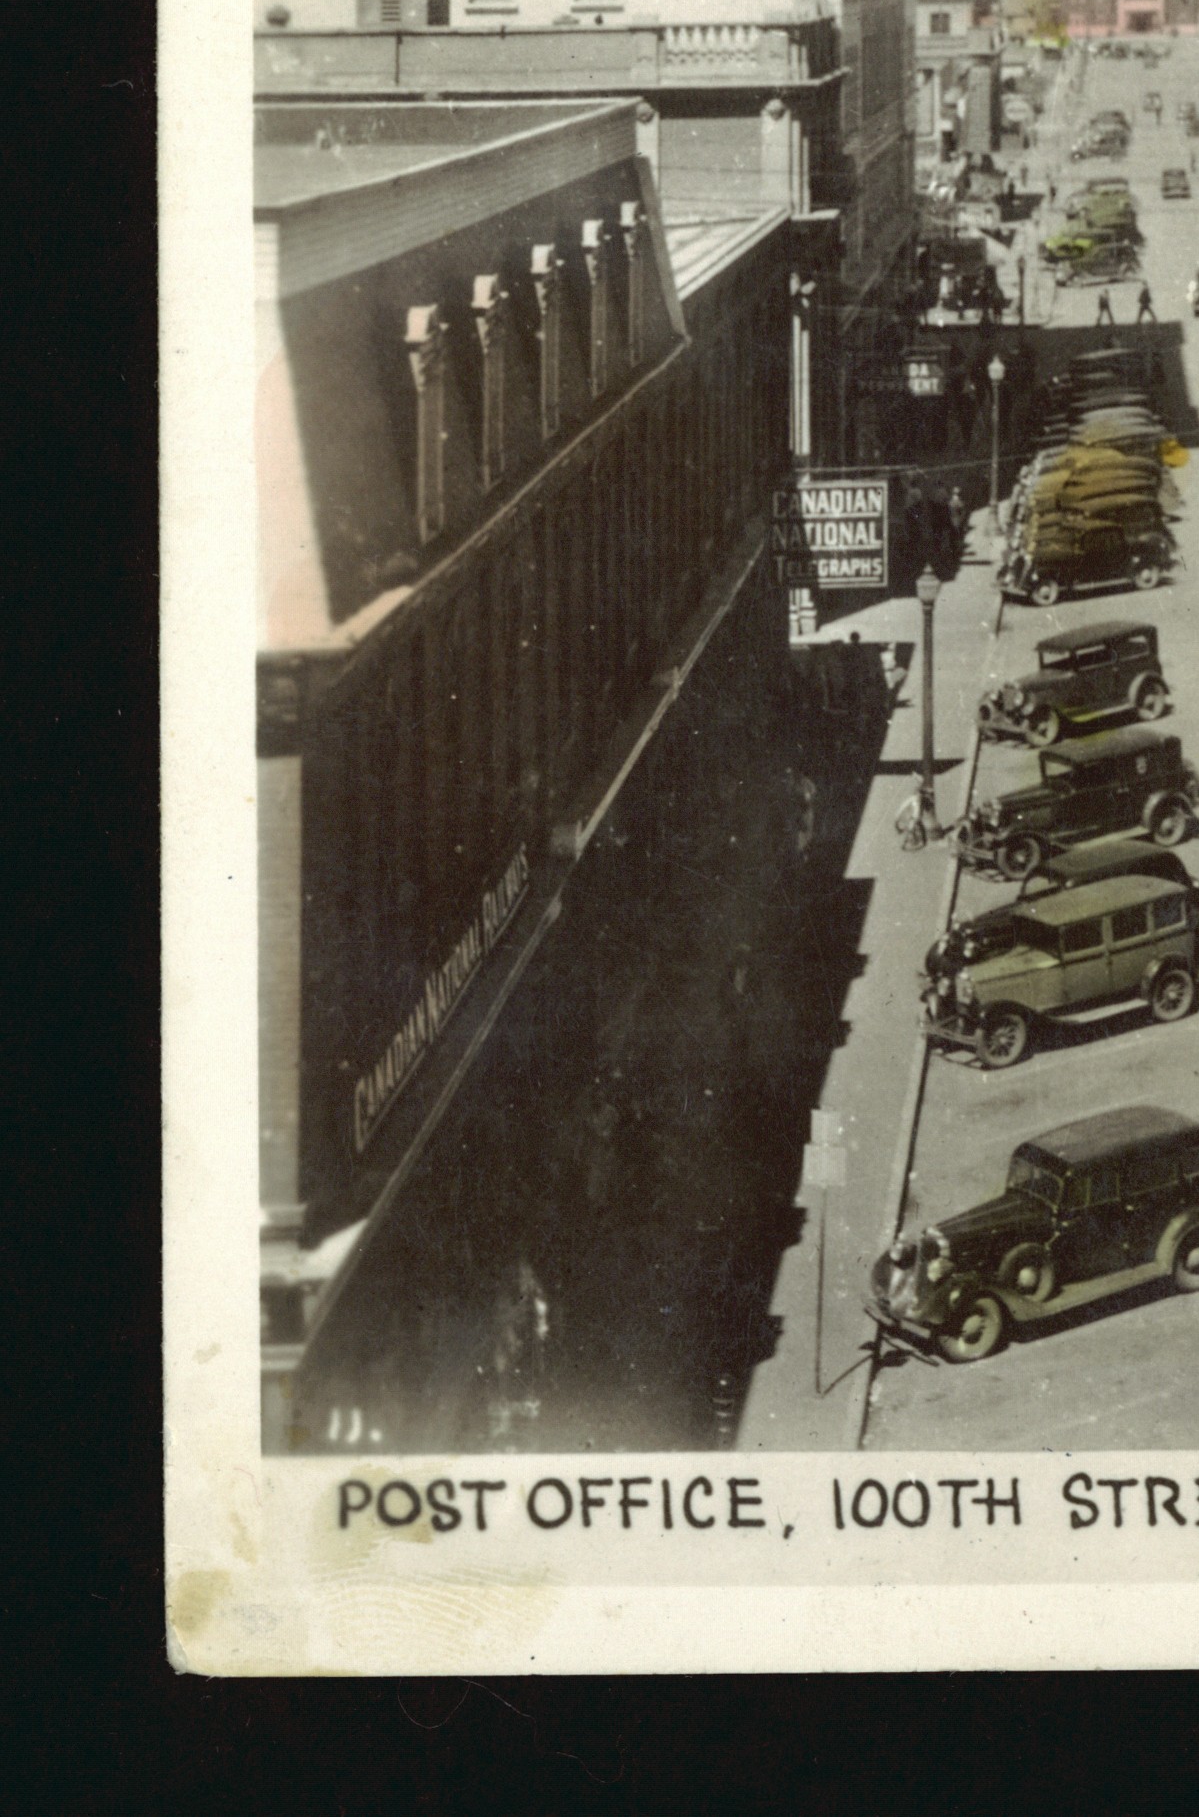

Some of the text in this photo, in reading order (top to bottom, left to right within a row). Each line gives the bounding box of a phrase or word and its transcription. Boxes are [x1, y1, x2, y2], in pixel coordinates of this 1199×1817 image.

[772, 488, 883, 519] CANADIAN
[772, 520, 883, 551] NATIONAL
[773, 555, 883, 584] TELEGRAPHS
